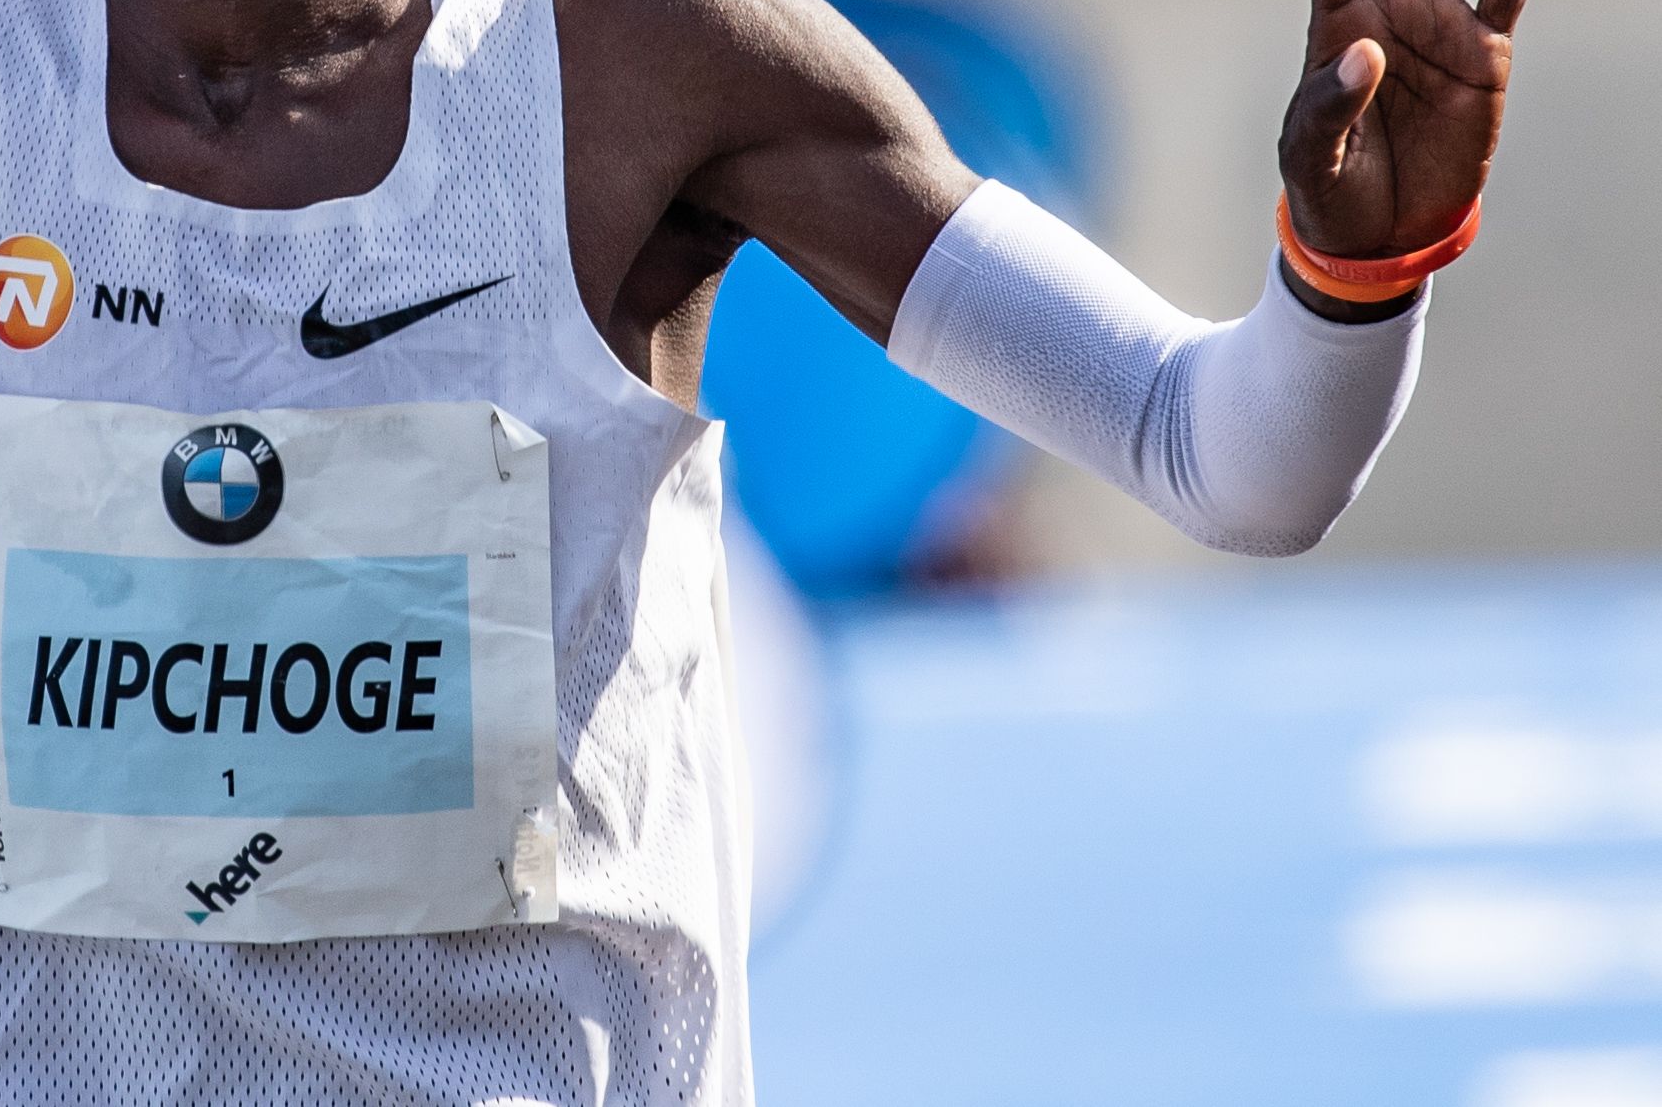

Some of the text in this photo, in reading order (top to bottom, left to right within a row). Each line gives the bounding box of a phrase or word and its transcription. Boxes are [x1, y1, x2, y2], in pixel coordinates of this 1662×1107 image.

[91, 283, 165, 328] NN
[173, 427, 274, 465] BMW
[27, 636, 443, 734] KIPCHOGE
[222, 768, 235, 798] 1
[185, 832, 283, 913] here
